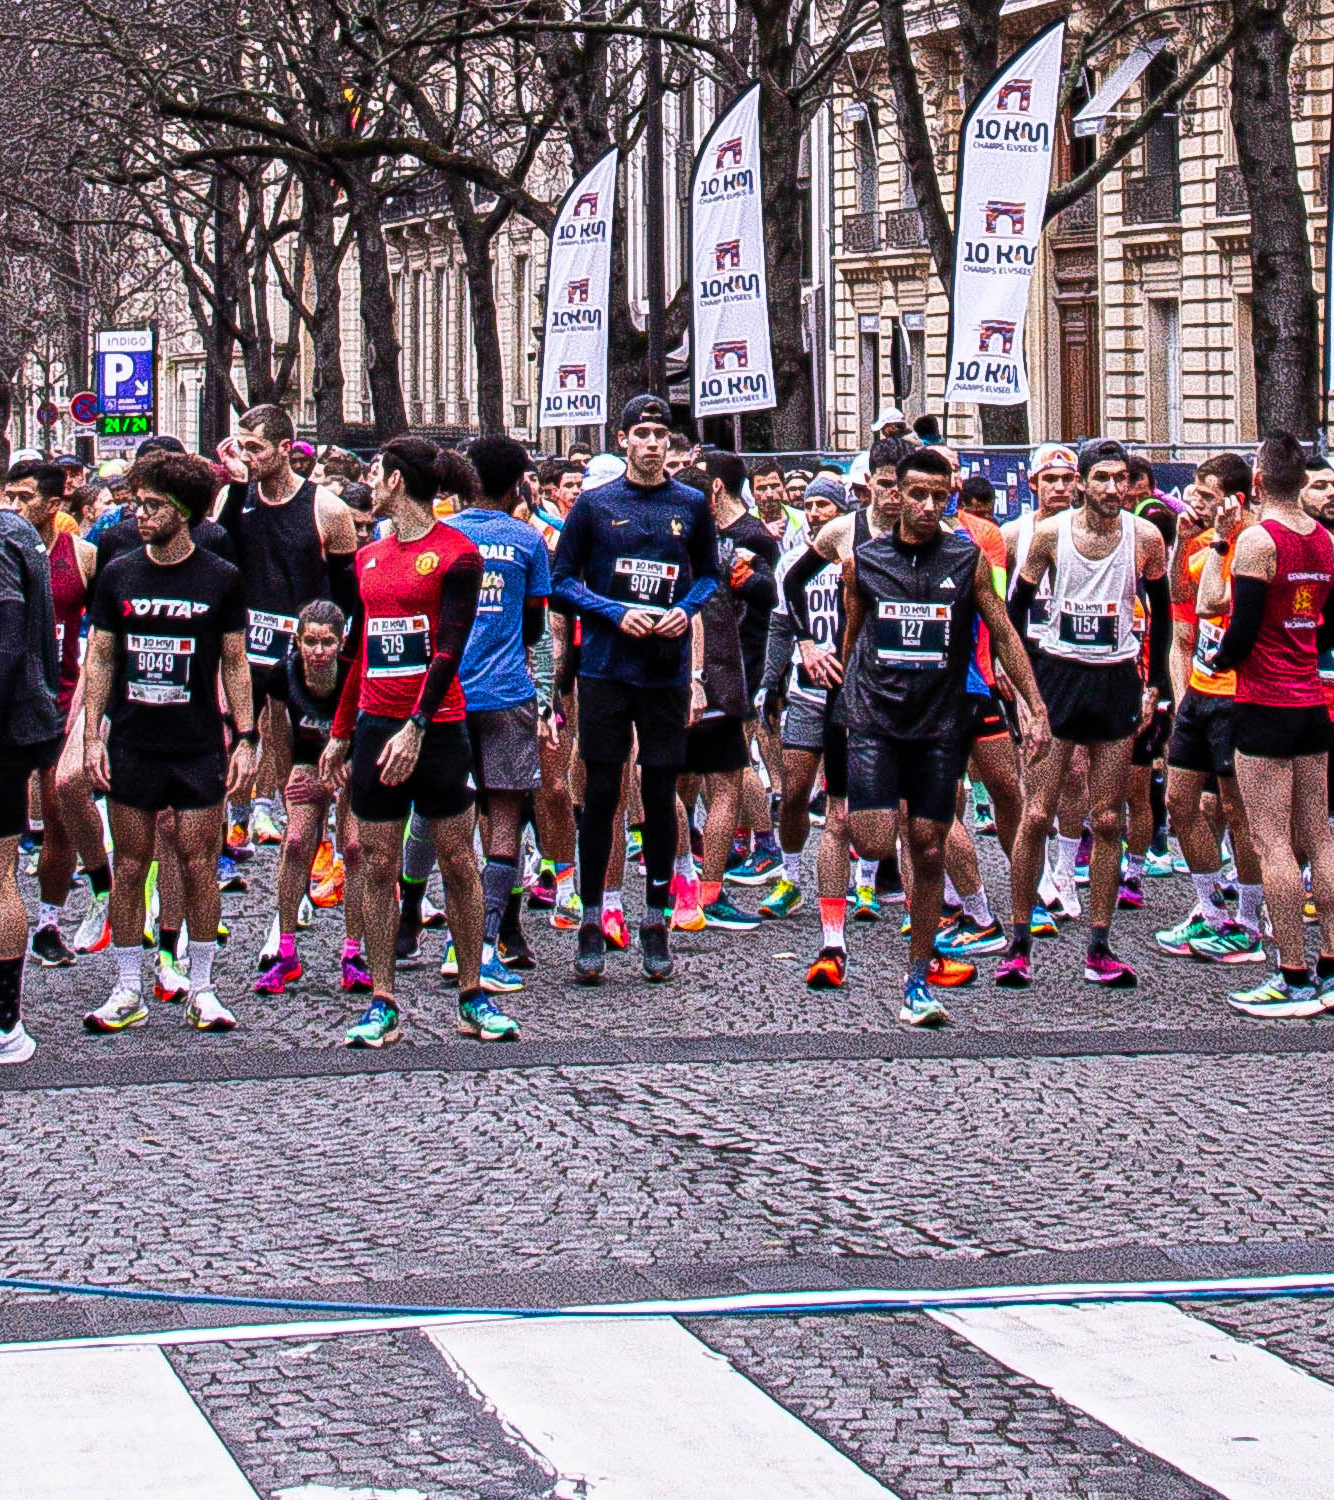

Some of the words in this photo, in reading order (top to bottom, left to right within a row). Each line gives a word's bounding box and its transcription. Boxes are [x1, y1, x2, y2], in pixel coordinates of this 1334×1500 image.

[975, 118, 1001, 139] 10
[964, 241, 990, 264] 10
[104, 353, 134, 397] P
[955, 361, 980, 382] 10
[699, 377, 722, 399] 10
[544, 395, 563, 412] 10
[249, 624, 274, 645] 440
[900, 619, 924, 640] 127
[1072, 616, 1099, 634] 1154
[381, 634, 405, 655] 579
[138, 652, 174, 673] 9049
